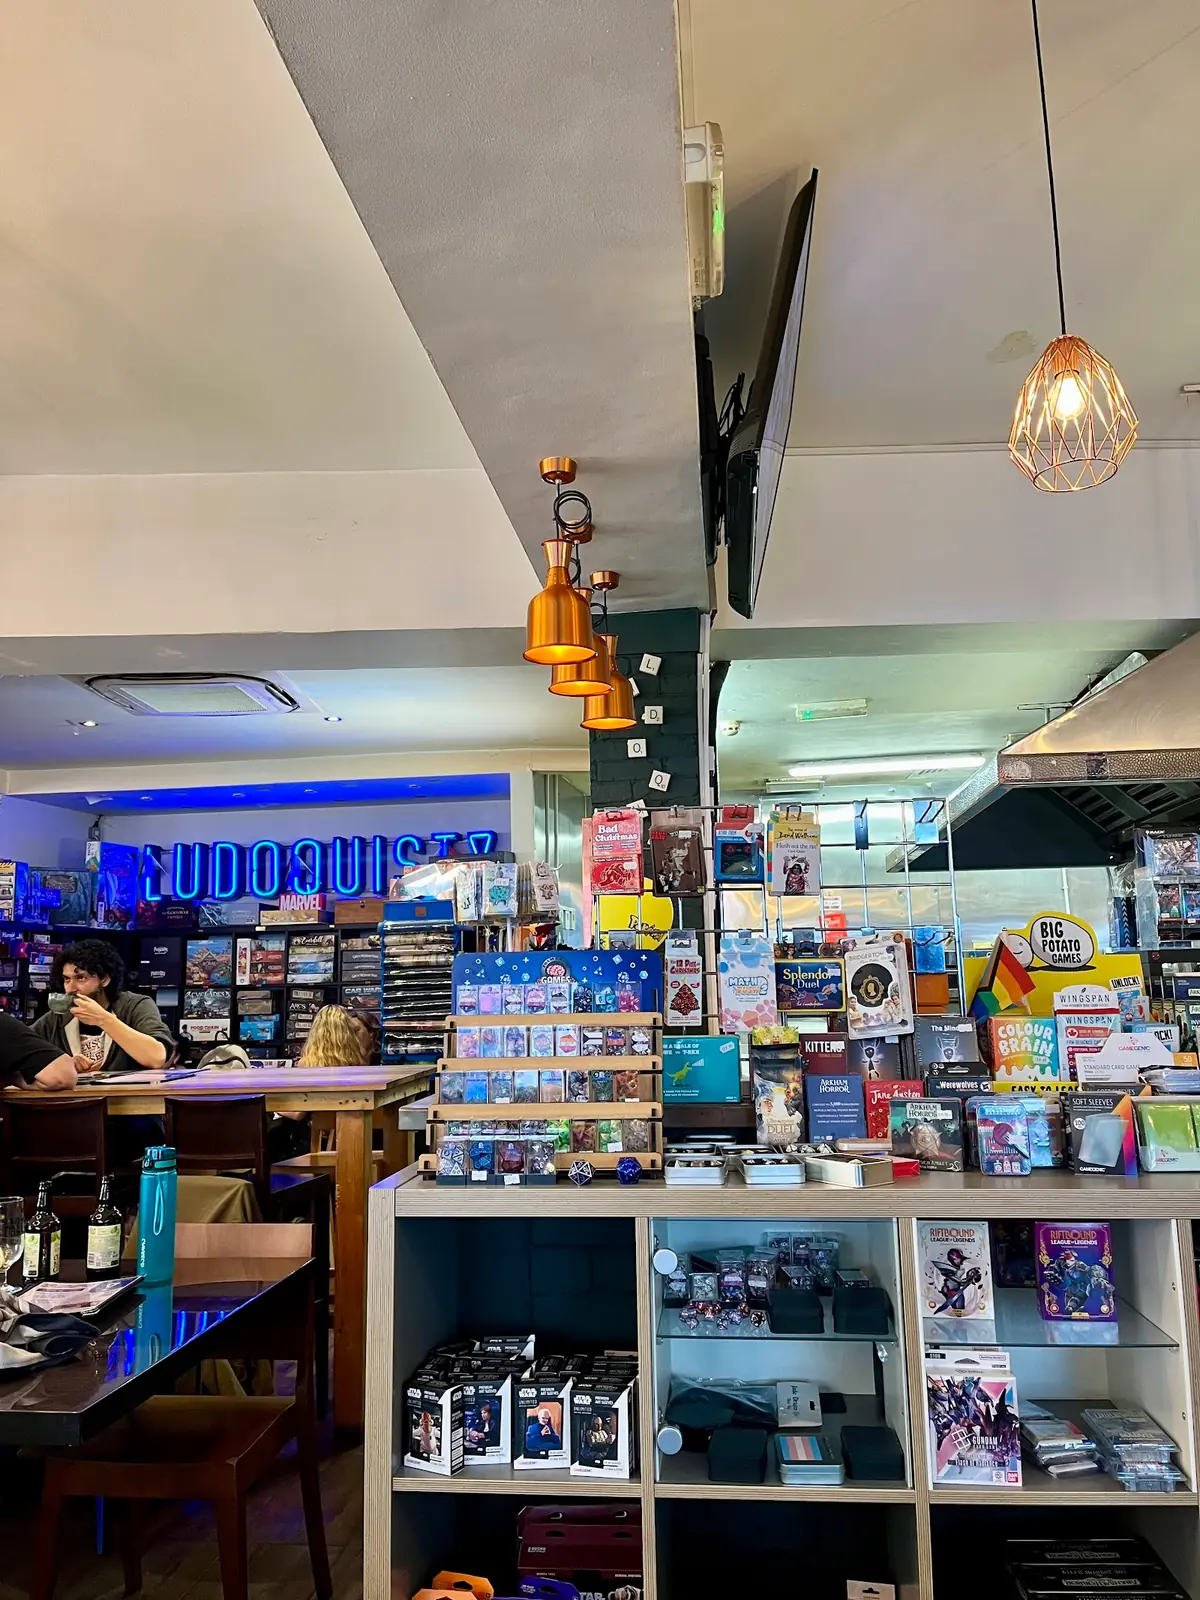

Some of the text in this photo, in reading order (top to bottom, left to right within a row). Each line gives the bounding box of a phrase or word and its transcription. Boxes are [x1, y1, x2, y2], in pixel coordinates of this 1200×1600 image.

[649, 709, 658, 720] D
[632, 743, 641, 754] O
[654, 774, 663, 787] Q
[597, 824, 619, 834] Bad
[595, 834, 638, 842] Christmas
[280, 894, 321, 911] MARVEL
[1040, 921, 1064, 939] BIG
[1042, 939, 1081, 953] POTATO
[676, 959, 684, 968] 12
[1052, 953, 1082, 964] GAMES
[541, 976, 571, 984] GAMES
[728, 976, 758, 987] MATH
[797, 978, 820, 989] Duel
[1111, 976, 1140, 989] UNLOCK!
[1060, 995, 1110, 1003] WINGSPAN
[1066, 1016, 1113, 1024] WINGSPAN
[997, 1023, 1054, 1041] COLOUR
[998, 1037, 1055, 1058] BRAIN
[1183, 1055, 1193, 1063] 50
[820, 1079, 848, 1087] ARKHAM
[940, 1081, 979, 1089] Werewolves
[820, 1085, 850, 1093] HORROR
[870, 1088, 921, 1104] Jane Austen
[909, 1103, 937, 1111] ARKHAM
[1072, 1098, 1114, 1106] SOFT SLEEVES
[930, 1228, 975, 1238] RIFTBOUND
[1050, 1230, 1097, 1240] RIFTBOUND
[972, 1436, 998, 1445] GUNDAM
